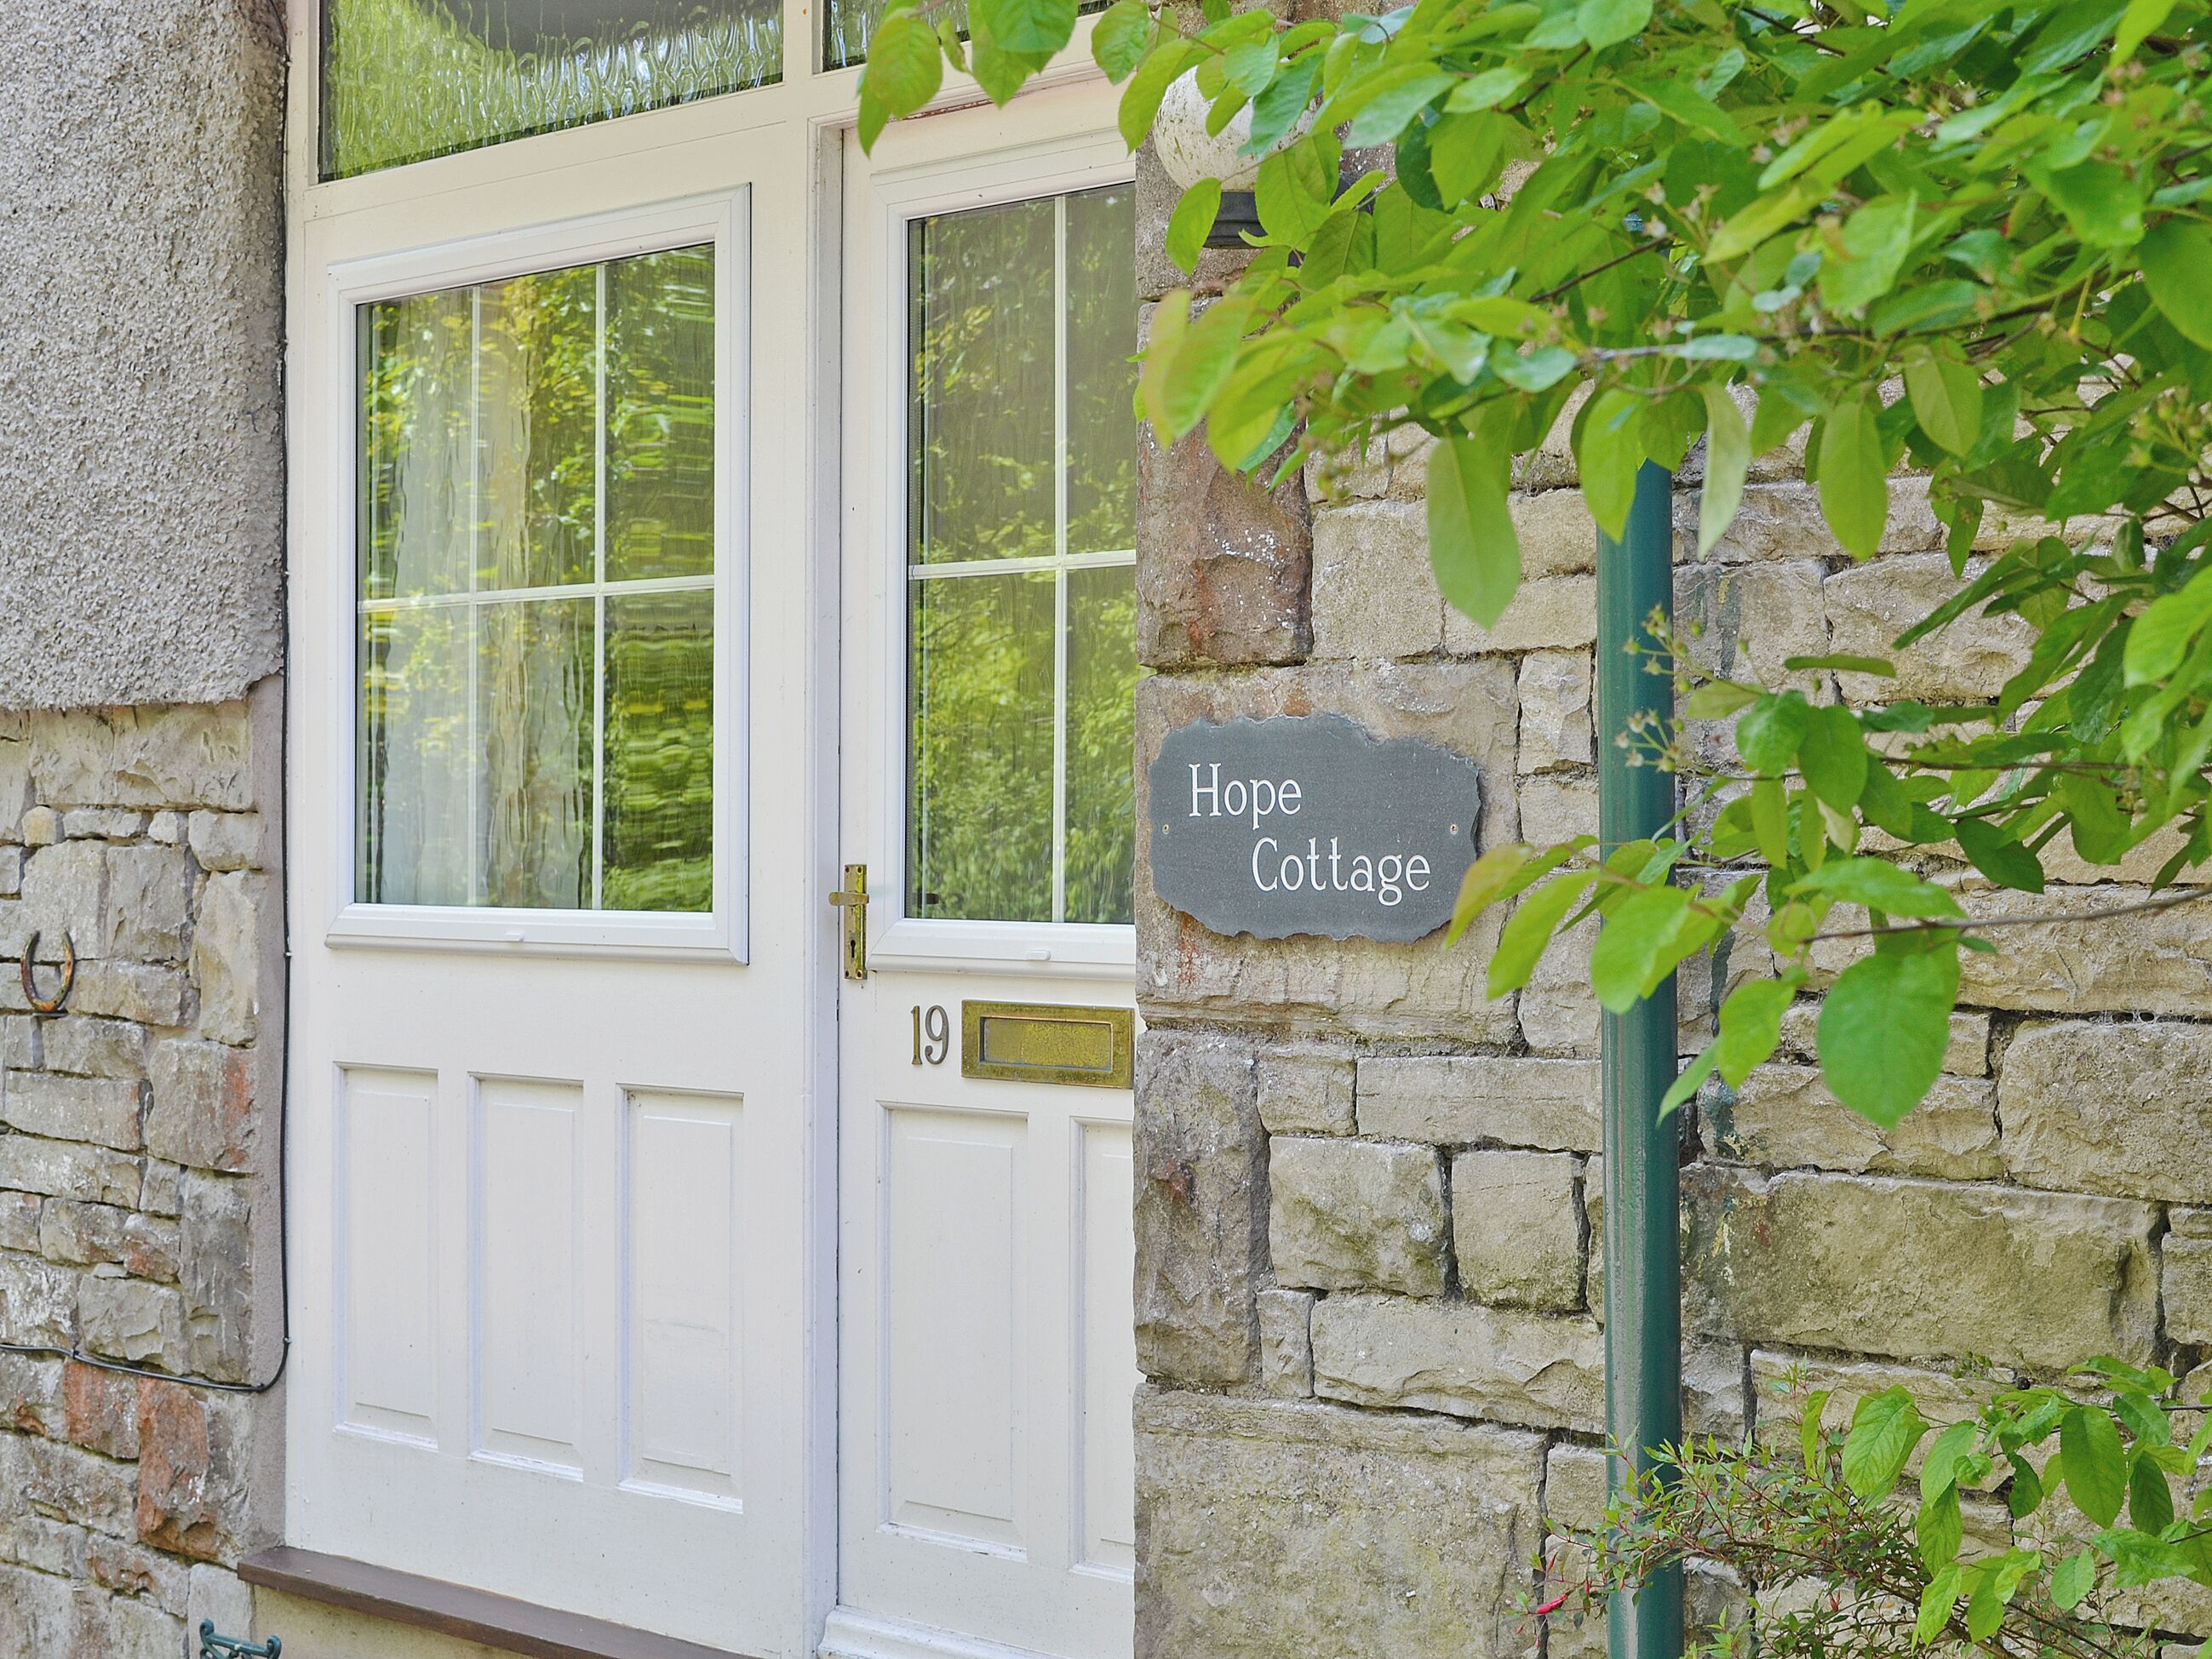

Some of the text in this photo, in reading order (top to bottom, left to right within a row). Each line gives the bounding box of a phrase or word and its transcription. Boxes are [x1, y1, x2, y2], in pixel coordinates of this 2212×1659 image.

[1189, 764, 1303, 830] Hope
[1252, 837, 1431, 906] Cottage
[910, 1004, 949, 1065] 19
